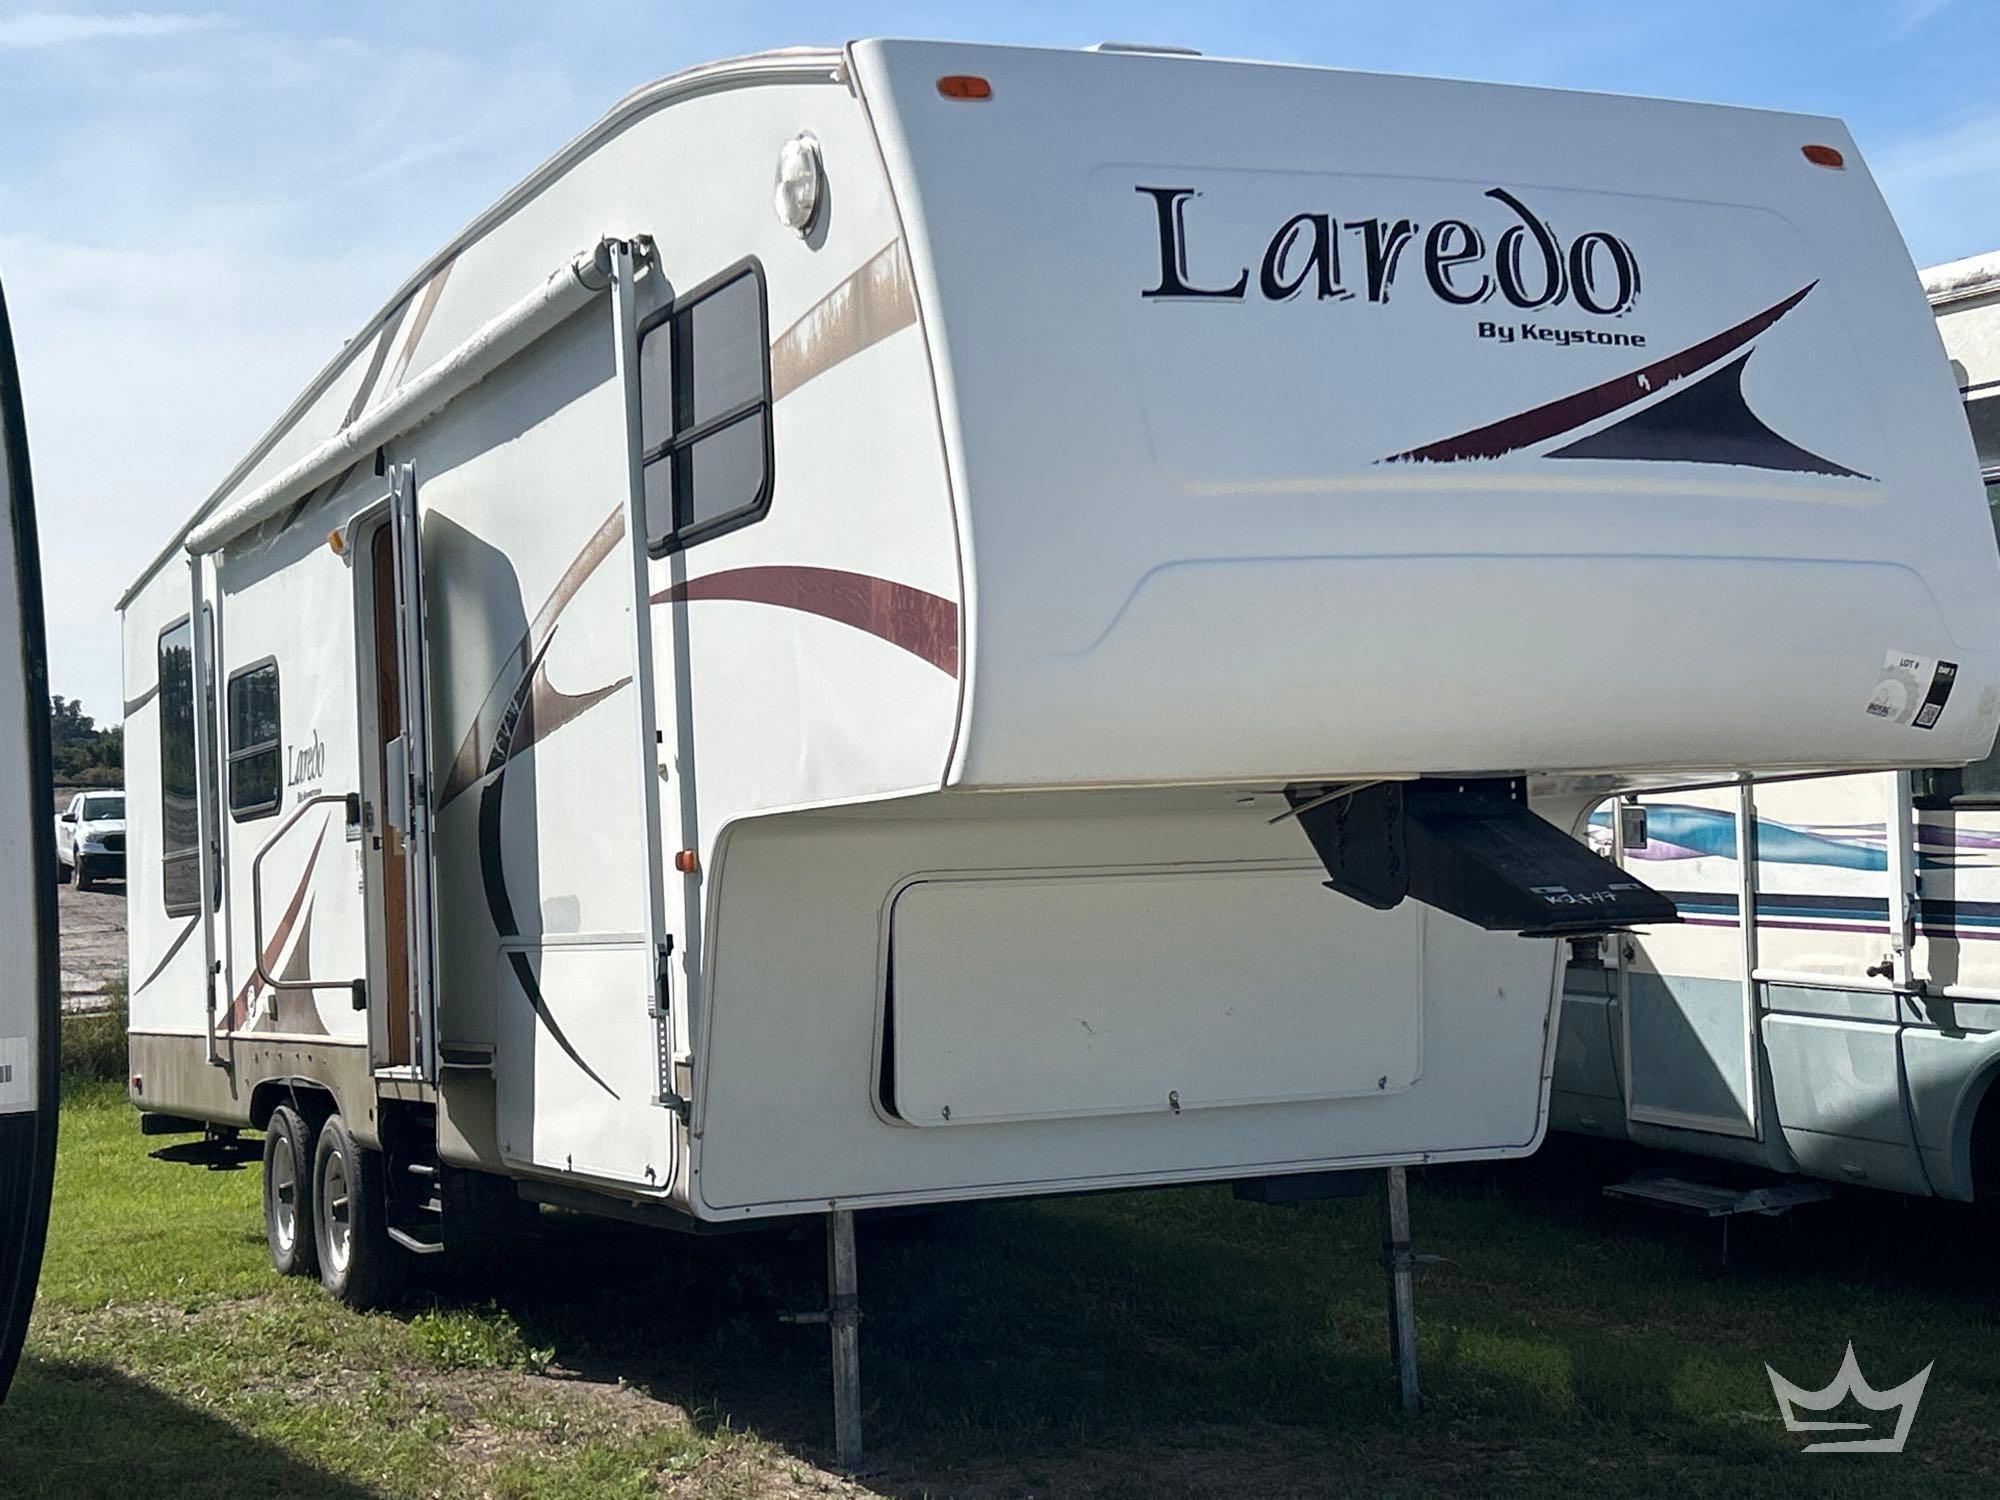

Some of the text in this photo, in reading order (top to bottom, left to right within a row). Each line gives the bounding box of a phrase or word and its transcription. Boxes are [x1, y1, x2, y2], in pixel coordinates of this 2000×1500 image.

[1135, 185, 1642, 318] Laredo
[1478, 321, 1647, 347] By Keystone
[288, 730, 324, 786] Laredo
